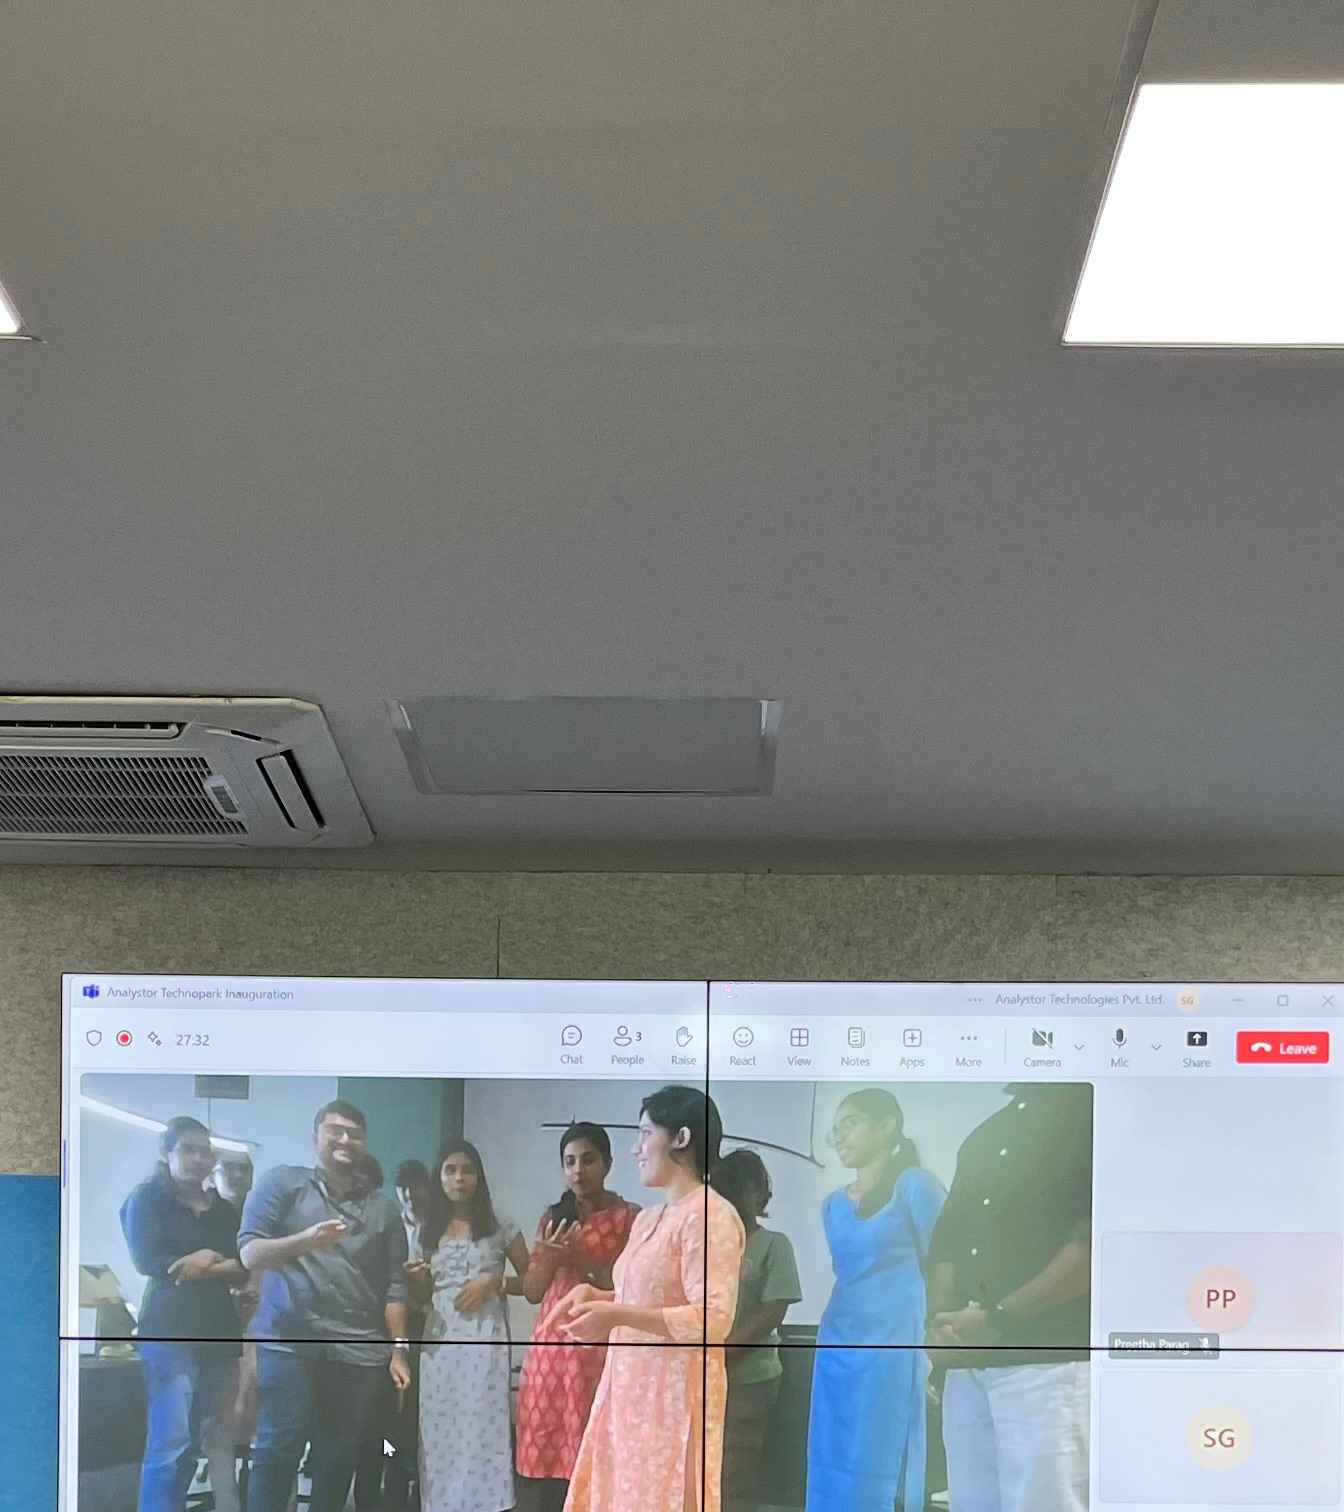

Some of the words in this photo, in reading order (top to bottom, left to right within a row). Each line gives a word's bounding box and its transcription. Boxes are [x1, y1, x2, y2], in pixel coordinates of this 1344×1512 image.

[106, 987, 158, 1002] Analystor
[162, 988, 223, 1001] Technopark
[225, 988, 294, 1002] Inauguration
[1049, 994, 1119, 1007] Technologies
[176, 1034, 210, 1047] 27:32
[635, 1032, 642, 1042] 3
[1279, 1042, 1317, 1055] Leave
[560, 1054, 583, 1065] Chat
[611, 1055, 645, 1069] People
[671, 1055, 697, 1066] Raise
[730, 1055, 757, 1067] React
[787, 1055, 812, 1067] View
[841, 1056, 871, 1067] Notes
[900, 1056, 926, 1071] Apps
[956, 1057, 983, 1067] More
[1023, 1057, 1062, 1068] Camera
[1111, 1057, 1129, 1068] Mic
[1182, 1057, 1212, 1068] Share
[1206, 1289, 1236, 1308] PP
[1204, 1428, 1236, 1448] SG
